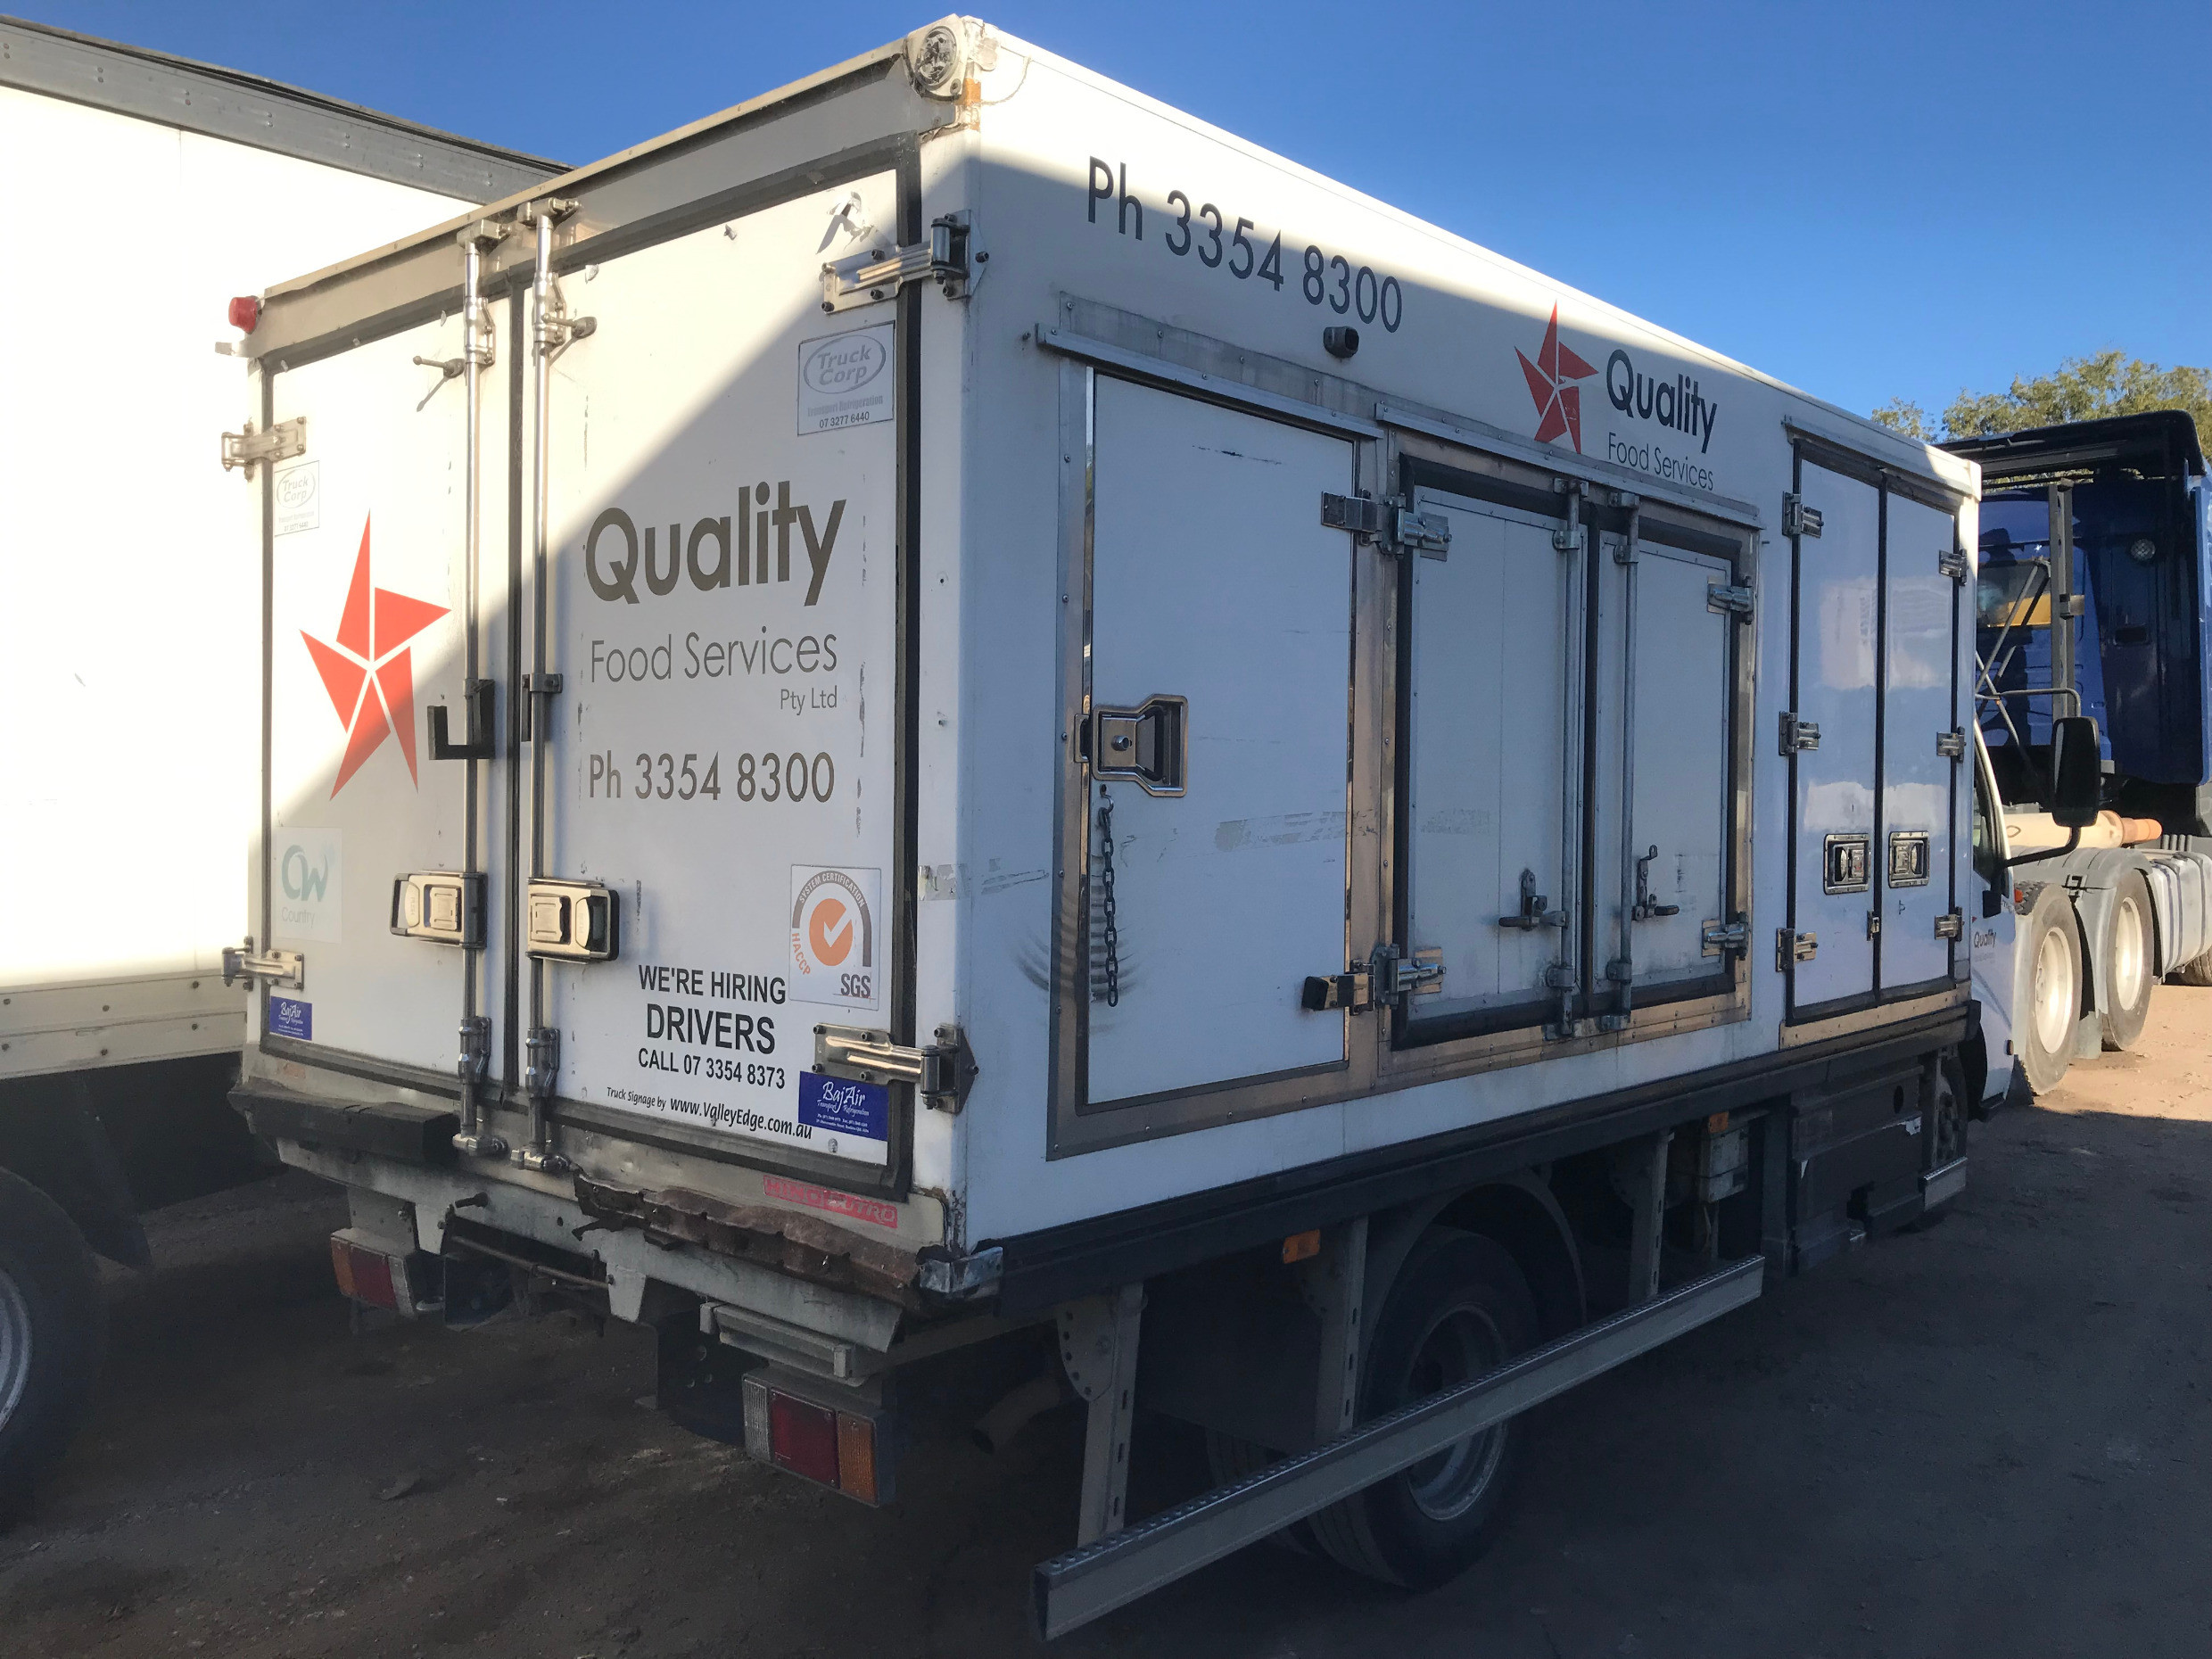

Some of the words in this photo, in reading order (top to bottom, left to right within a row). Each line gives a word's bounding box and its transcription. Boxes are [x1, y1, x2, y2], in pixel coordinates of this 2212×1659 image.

[1087, 155, 1143, 241] Ph
[1165, 190, 1283, 292] 3354
[1303, 245, 1402, 334] 8300
[817, 344, 872, 369] Truck
[819, 366, 868, 385] Corp
[819, 418, 829, 429] 07
[830, 415, 848, 427] 3277
[850, 411, 870, 424] 6440
[1606, 349, 1717, 454] Quality
[1608, 432, 1649, 471] Food
[1655, 447, 1713, 491] Services
[283, 475, 309, 491] Truck
[284, 490, 307, 502] Corp
[586, 480, 846, 607] Quality
[591, 633, 672, 682] Food
[684, 626, 838, 679] Services
[780, 688, 805, 715] Pty
[811, 685, 838, 709] Ltd
[590, 750, 622, 798] Ph
[635, 751, 721, 800] 3354
[737, 751, 835, 803] 8300
[799, 876, 821, 904] SYSTEM
[821, 872, 865, 909] CERTIFICATION
[281, 906, 316, 929] Country
[791, 932, 811, 976] HACCP
[639, 964, 704, 995] WE'RE
[711, 970, 786, 1004] HIRING
[840, 973, 871, 998] SGS
[647, 1003, 775, 1054] DRIVERS
[638, 1048, 679, 1072] CALL
[683, 1053, 701, 1076] 07
[706, 1057, 742, 1082] 3354
[747, 1063, 786, 1089] 8373
[607, 1086, 626, 1100] Truck
[627, 1091, 656, 1108] Signage
[656, 1097, 666, 1111] by
[670, 1098, 813, 1139] www.ValleyEdge.com.au
